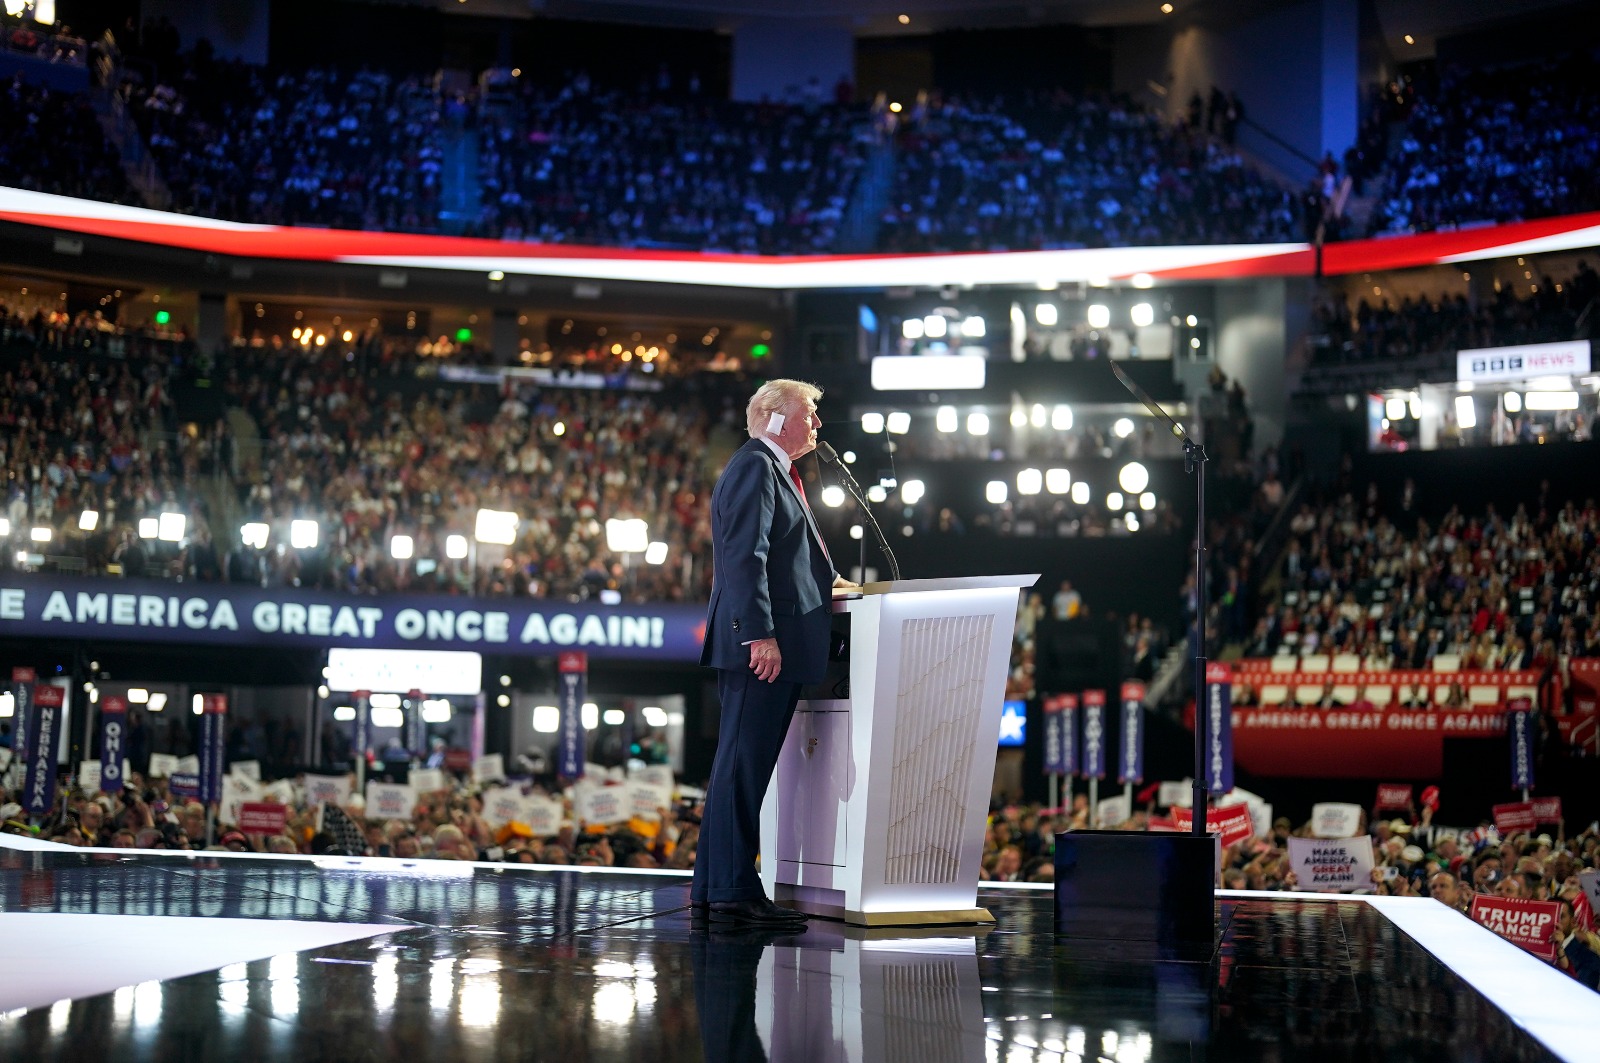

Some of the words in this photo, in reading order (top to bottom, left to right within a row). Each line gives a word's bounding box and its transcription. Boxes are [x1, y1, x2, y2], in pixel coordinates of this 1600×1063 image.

[1472, 354, 1523, 374] BBC
[1528, 352, 1575, 369] NEWS
[41, 590, 239, 631] AMERICA
[252, 601, 383, 638] GREAT
[394, 608, 510, 643] ONCE
[520, 613, 664, 648] AGAIN!
[1245, 711, 1322, 729] AMERICA
[1326, 712, 1381, 731] GREAT
[1387, 713, 1438, 731] ONCE
[31, 707, 55, 809] NEBRASKA
[104, 721, 122, 780] OHIO
[1303, 856, 1358, 866] AMERICA
[1312, 847, 1347, 856] MAKE
[1312, 864, 1352, 874] GREAT
[1313, 873, 1354, 882] AGAIN!
[1478, 906, 1552, 926] TRUMP
